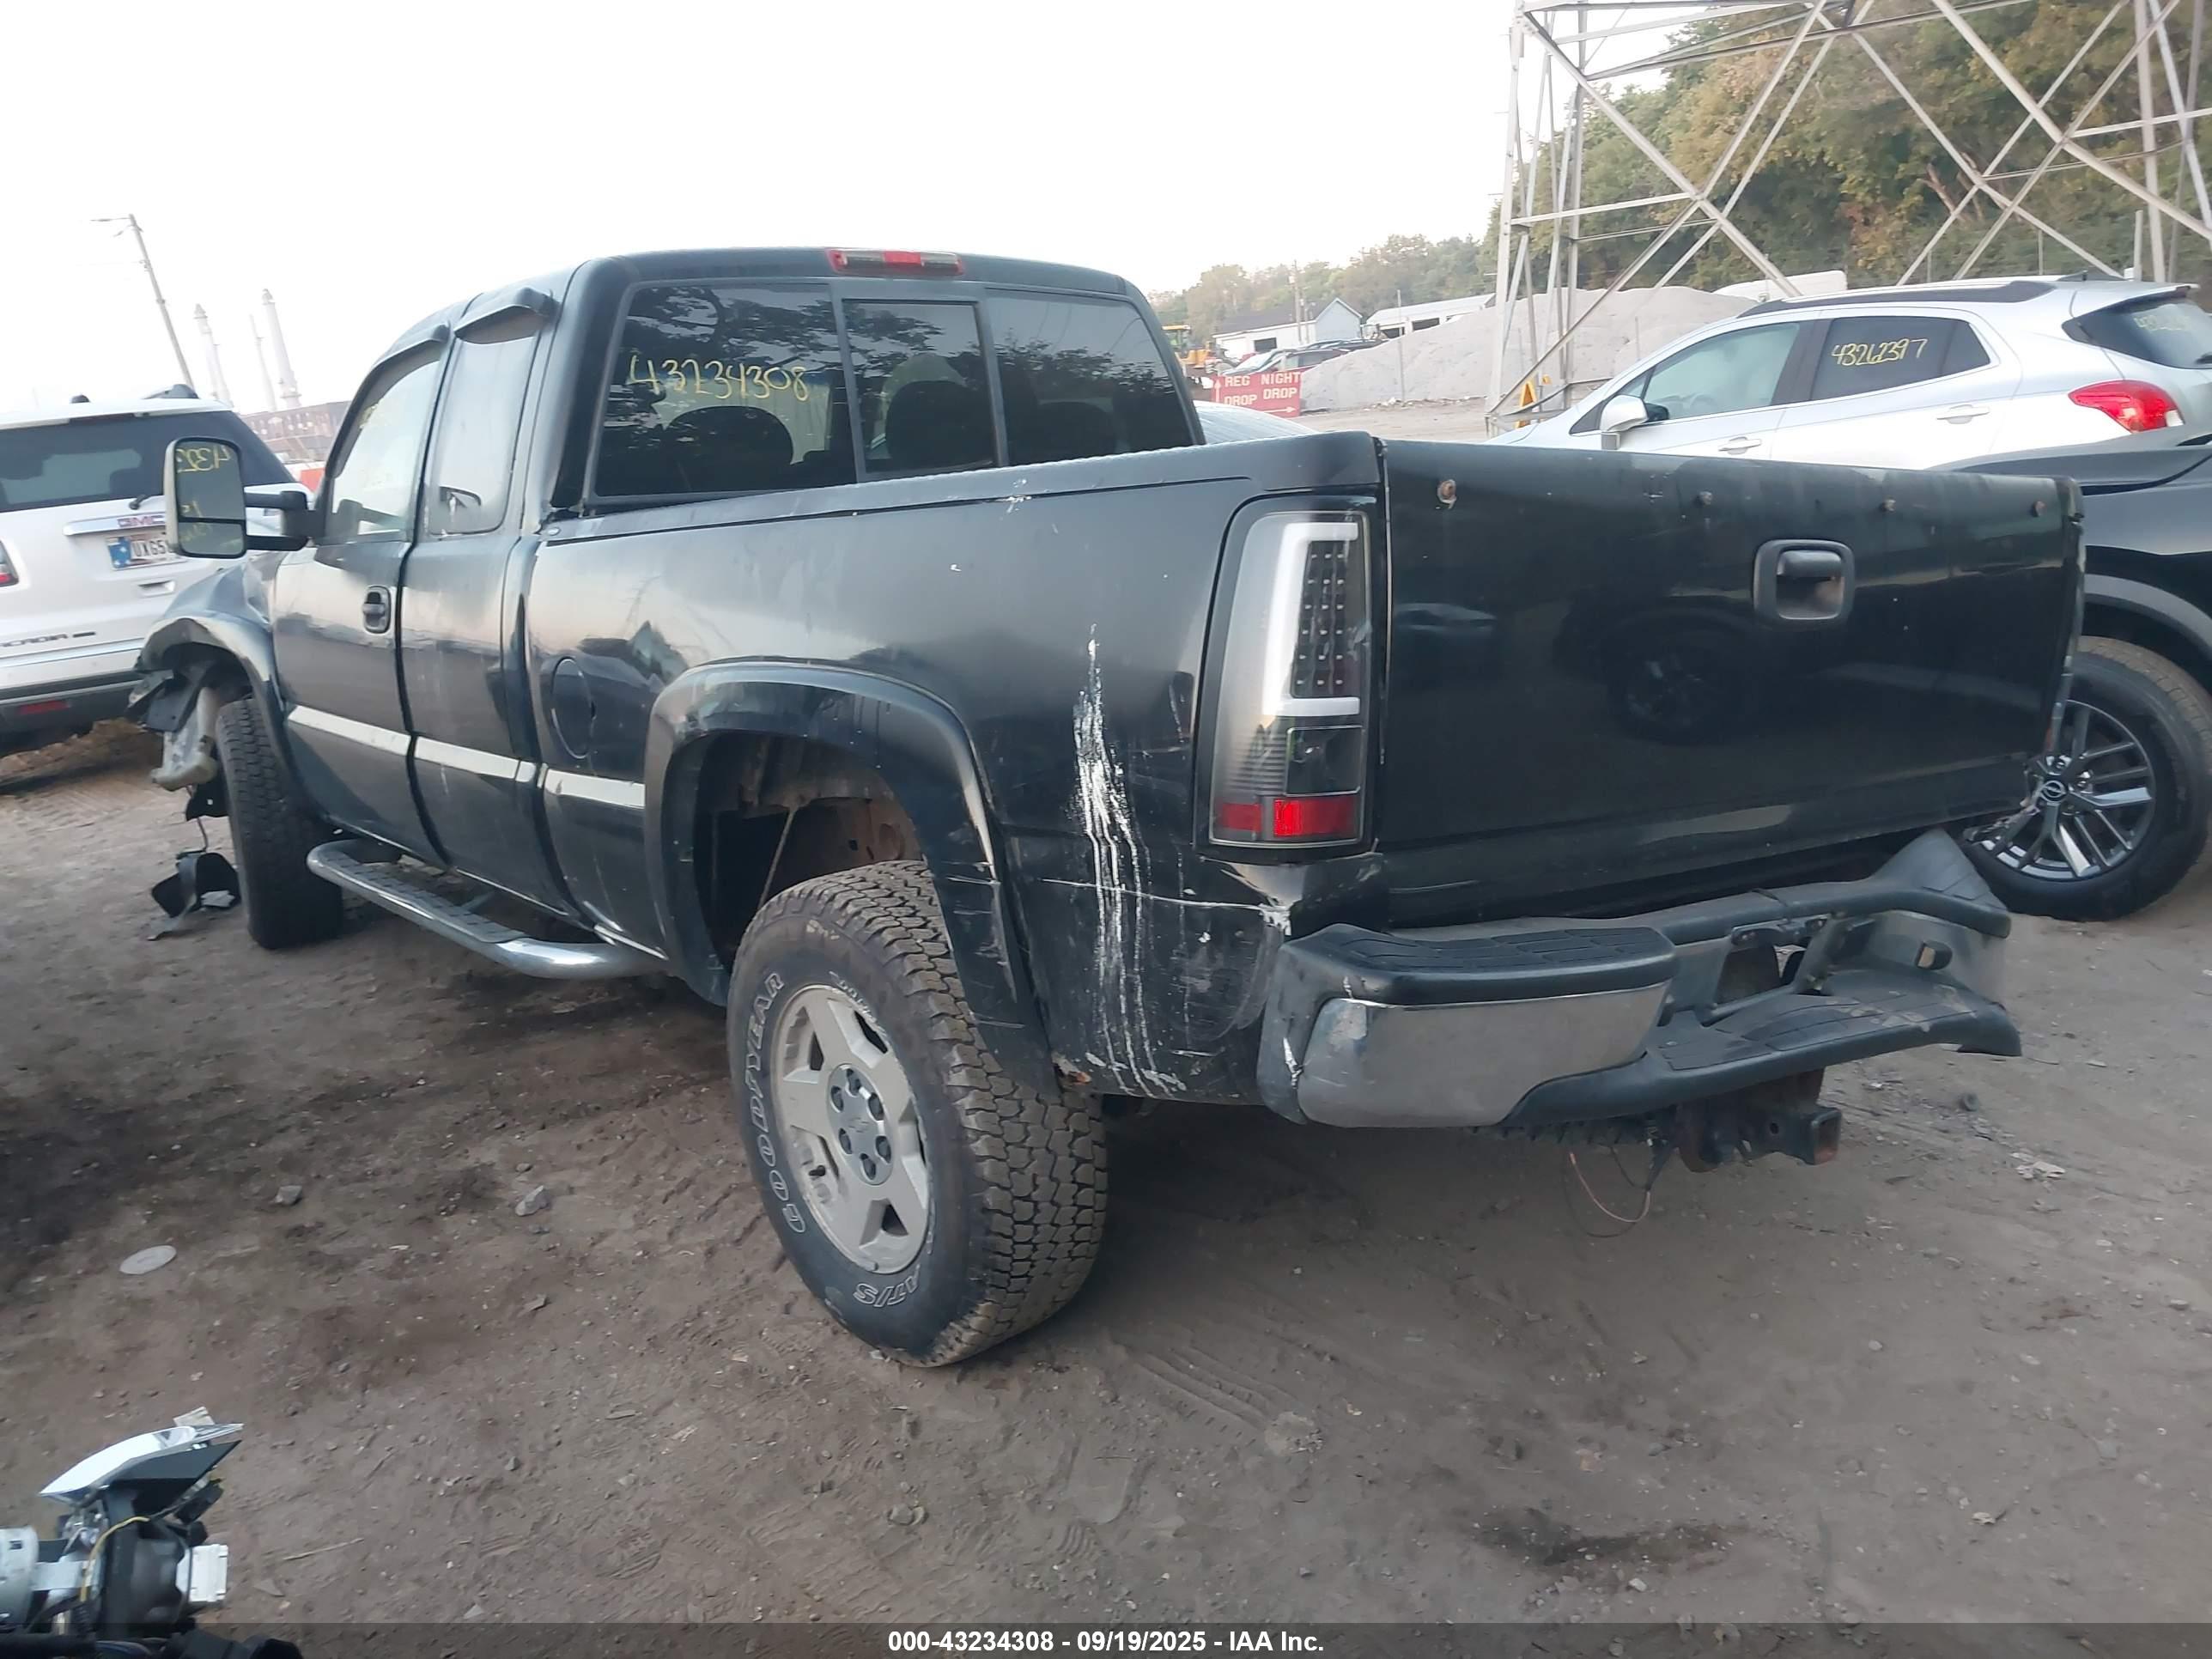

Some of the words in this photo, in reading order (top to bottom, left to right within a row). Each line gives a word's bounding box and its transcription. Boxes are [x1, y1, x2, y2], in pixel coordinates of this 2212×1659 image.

[628, 354, 809, 401] 43234308
[1224, 375, 1250, 387] REG
[1261, 372, 1301, 386] NIGHT
[1224, 394, 1258, 406] DROP
[1263, 387, 1297, 400] DROP
[117, 515, 165, 528] GMC
[745, 972, 805, 1233] GOODYEAR
